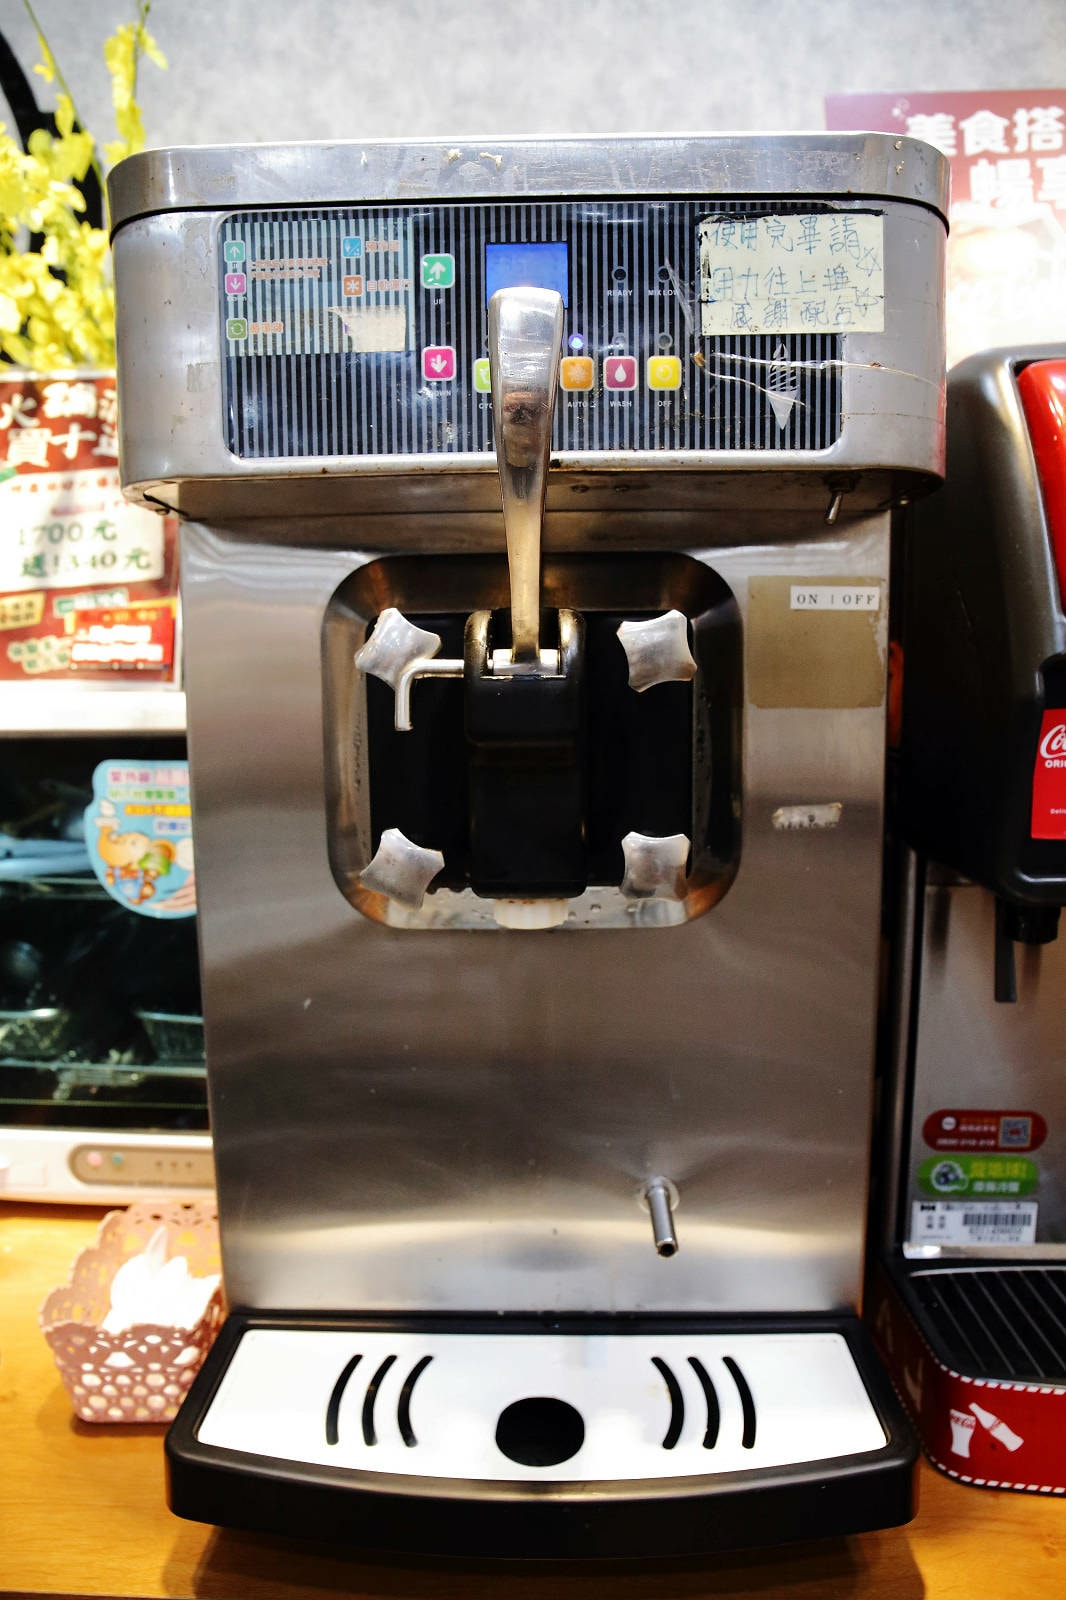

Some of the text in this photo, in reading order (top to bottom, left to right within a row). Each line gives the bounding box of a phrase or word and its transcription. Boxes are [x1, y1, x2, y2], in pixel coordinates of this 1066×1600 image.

[905, 107, 1065, 156] 美食搭
[731, 295, 856, 330] 感謝配合
[796, 593, 818, 605] ON
[842, 593, 876, 605] OFF
